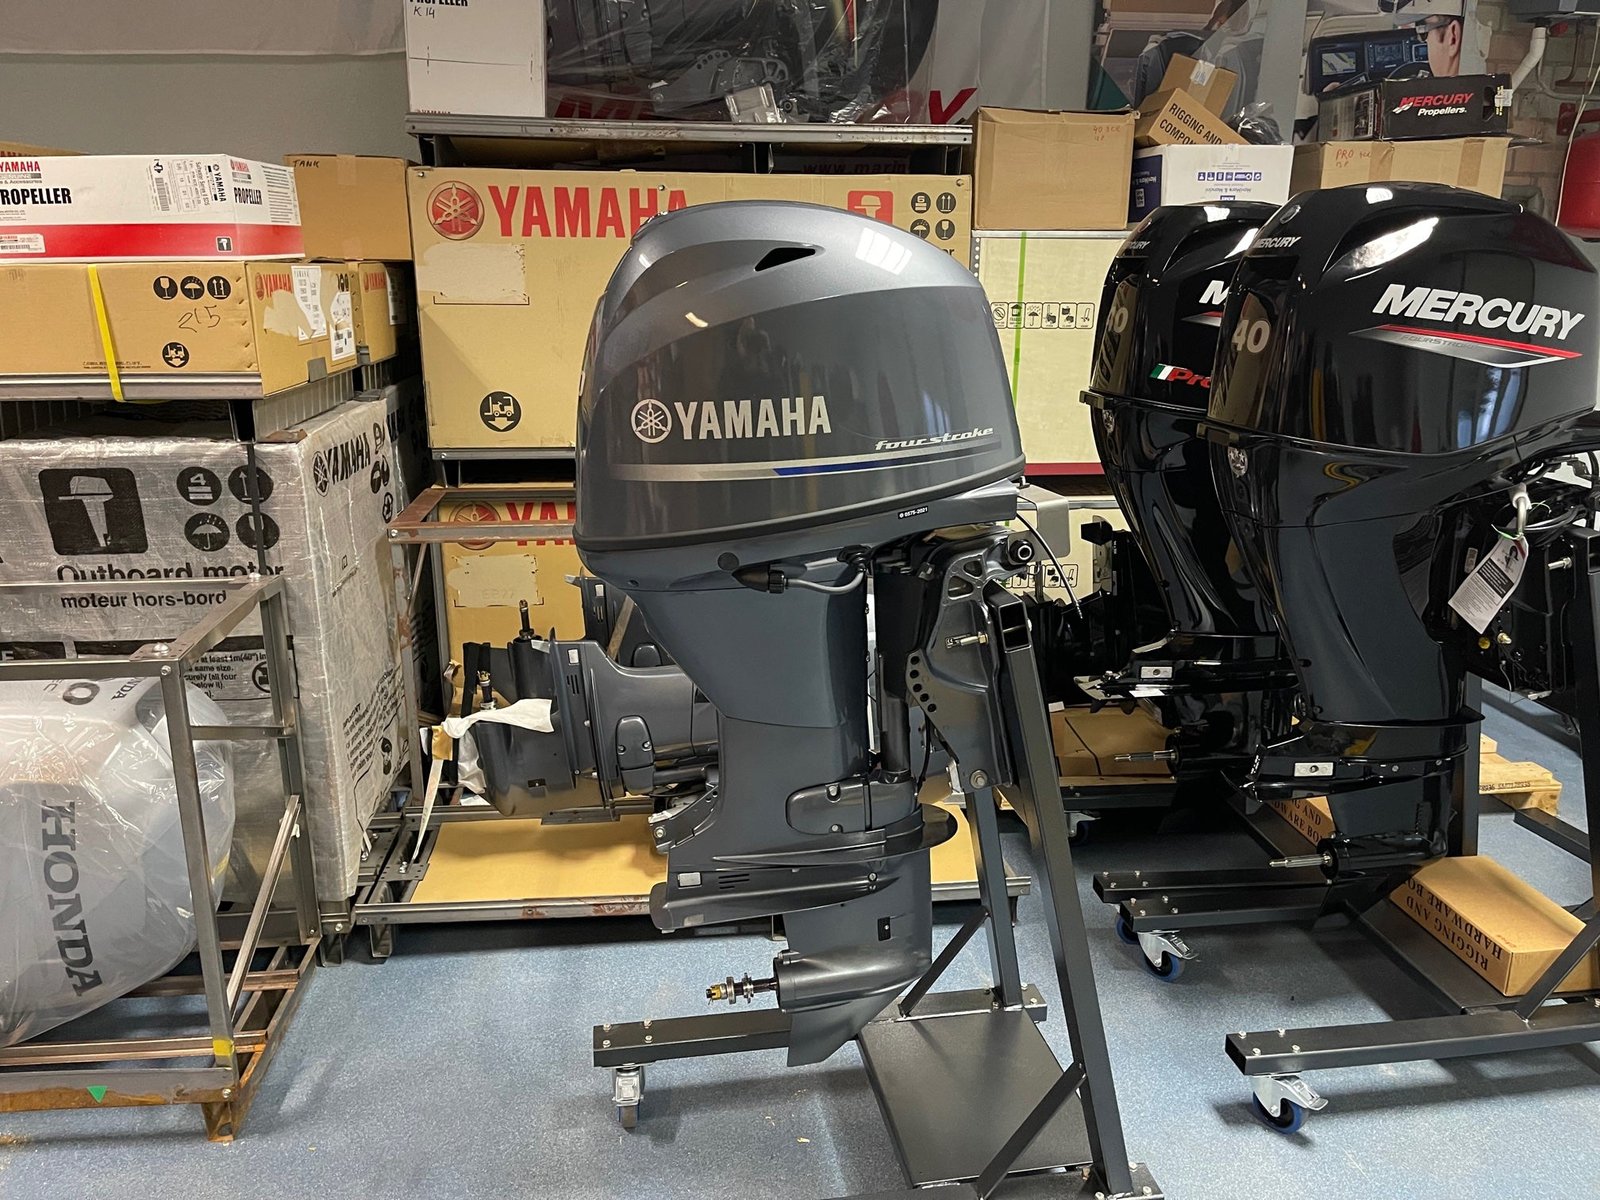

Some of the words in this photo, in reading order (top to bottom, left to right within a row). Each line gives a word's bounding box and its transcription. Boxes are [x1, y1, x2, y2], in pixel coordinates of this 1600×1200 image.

[413, 6, 422, 16] K
[425, 7, 435, 19] 14
[1400, 93, 1474, 107] MERCURY
[1168, 103, 1204, 135] RIGGING
[1203, 130, 1223, 145] AND
[0, 161, 41, 172] YAMAHA
[293, 160, 319, 168] TANK
[213, 172, 227, 202] YAMAHA
[233, 187, 262, 205] PROPELLER
[1254, 237, 1301, 249] MERCURY
[178, 305, 221, 332] 215
[1372, 283, 1585, 340] MERCURY
[1231, 319, 1271, 353] 40
[674, 395, 832, 440] YAMAHA
[323, 432, 371, 485] YAMAHA
[57, 562, 193, 581] Outboard
[60, 593, 127, 608] moteur
[132, 590, 227, 607] hors-bord
[1303, 805, 1322, 826] AND
[42, 800, 104, 997] HONDA
[1406, 877, 1426, 896] BO
[1406, 895, 1432, 920] AND
[1428, 896, 1502, 960] HARDWARE
[1434, 914, 1489, 971] RIGGING
